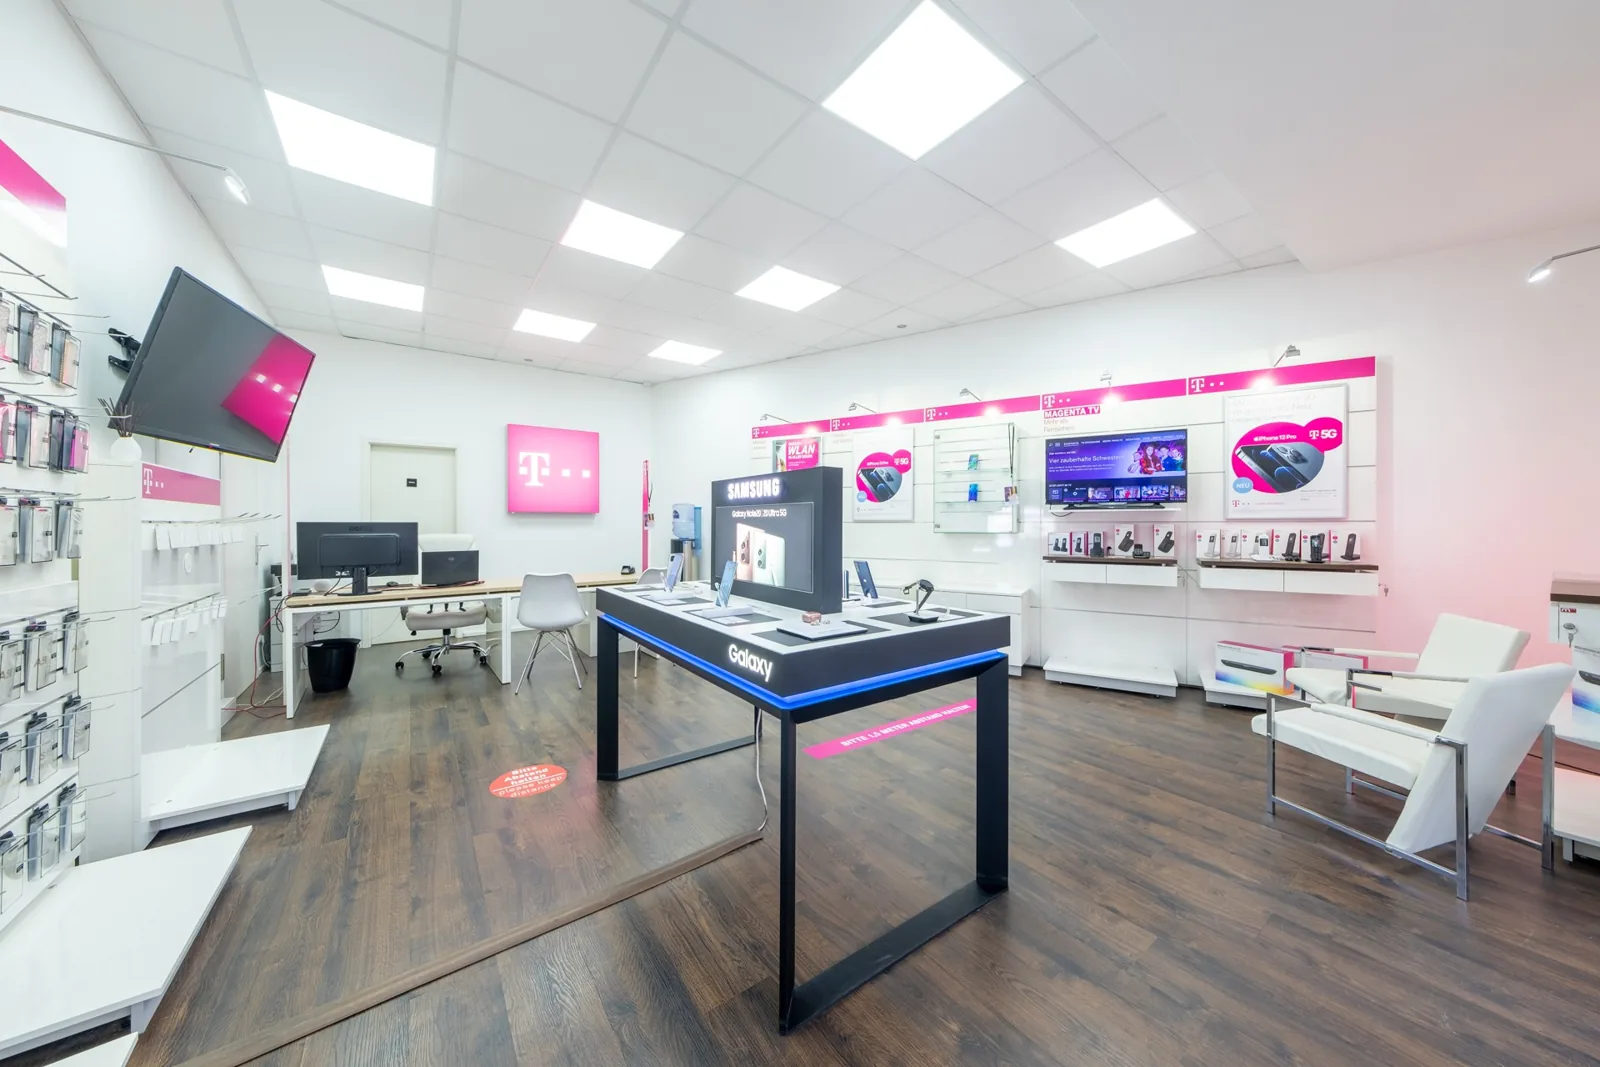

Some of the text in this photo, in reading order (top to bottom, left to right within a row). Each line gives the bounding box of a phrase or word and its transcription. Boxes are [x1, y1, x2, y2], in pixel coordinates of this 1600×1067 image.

[1044, 406, 1100, 418] MAGENTA TV
[1320, 429, 1338, 439] 5G
[787, 443, 816, 456] WLAN
[727, 478, 780, 500] SAMSUNG
[728, 643, 773, 682] Galaxy
[840, 735, 869, 747] BITTE
[504, 768, 549, 783] Abstand
[511, 766, 538, 775] Bitte
